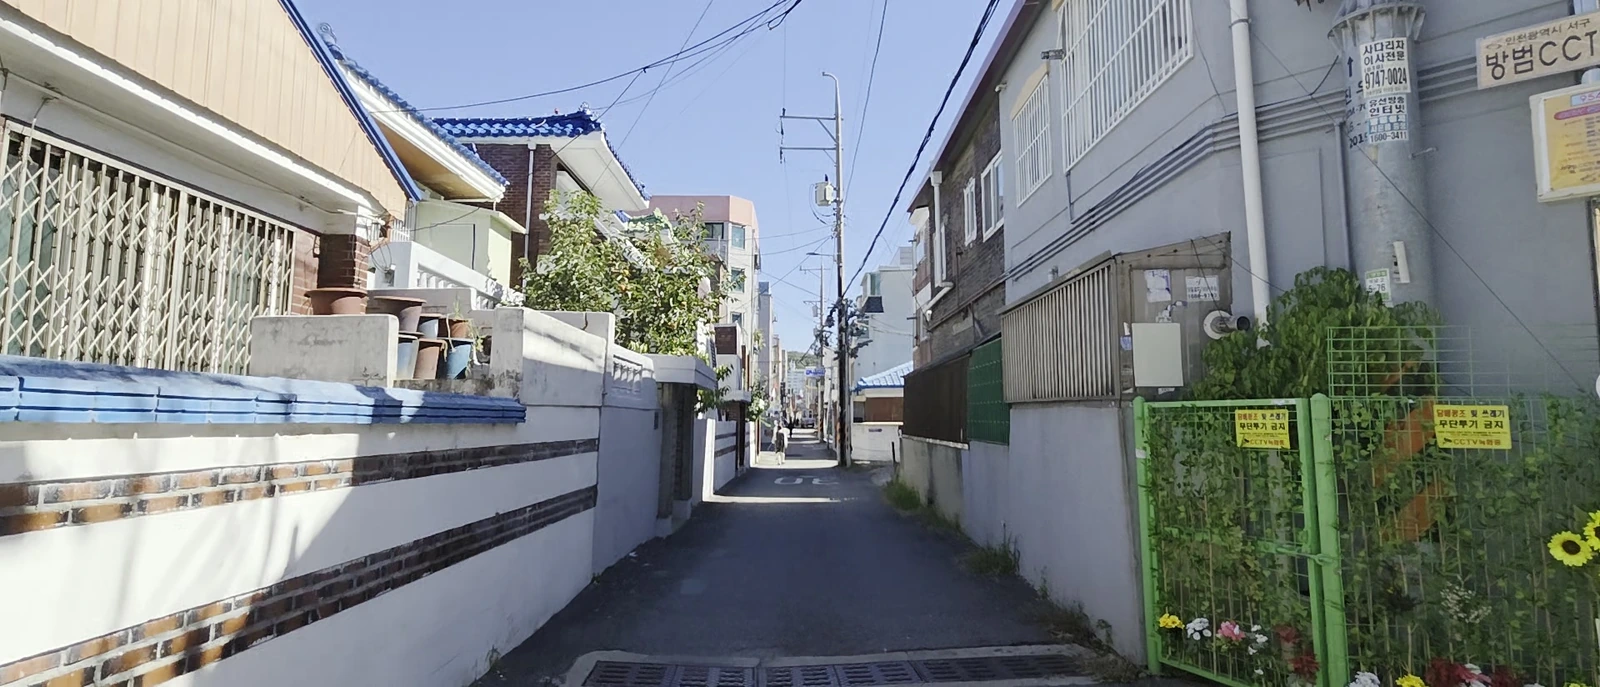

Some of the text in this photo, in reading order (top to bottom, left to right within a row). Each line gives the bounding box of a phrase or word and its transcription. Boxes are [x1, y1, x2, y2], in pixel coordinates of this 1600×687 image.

[1505, 18, 1590, 46] 인천광역시 서구
[1365, 67, 1407, 90] 9747-0024
[1369, 96, 1405, 108] 유선방송
[1369, 104, 1405, 117] 인터넷
[1370, 131, 1407, 143] 1600-3411
[1482, 409, 1505, 418] 쓰레기
[1239, 422, 1286, 431] 무단투기 금지
[1439, 419, 1504, 429] 무단투기 금지
